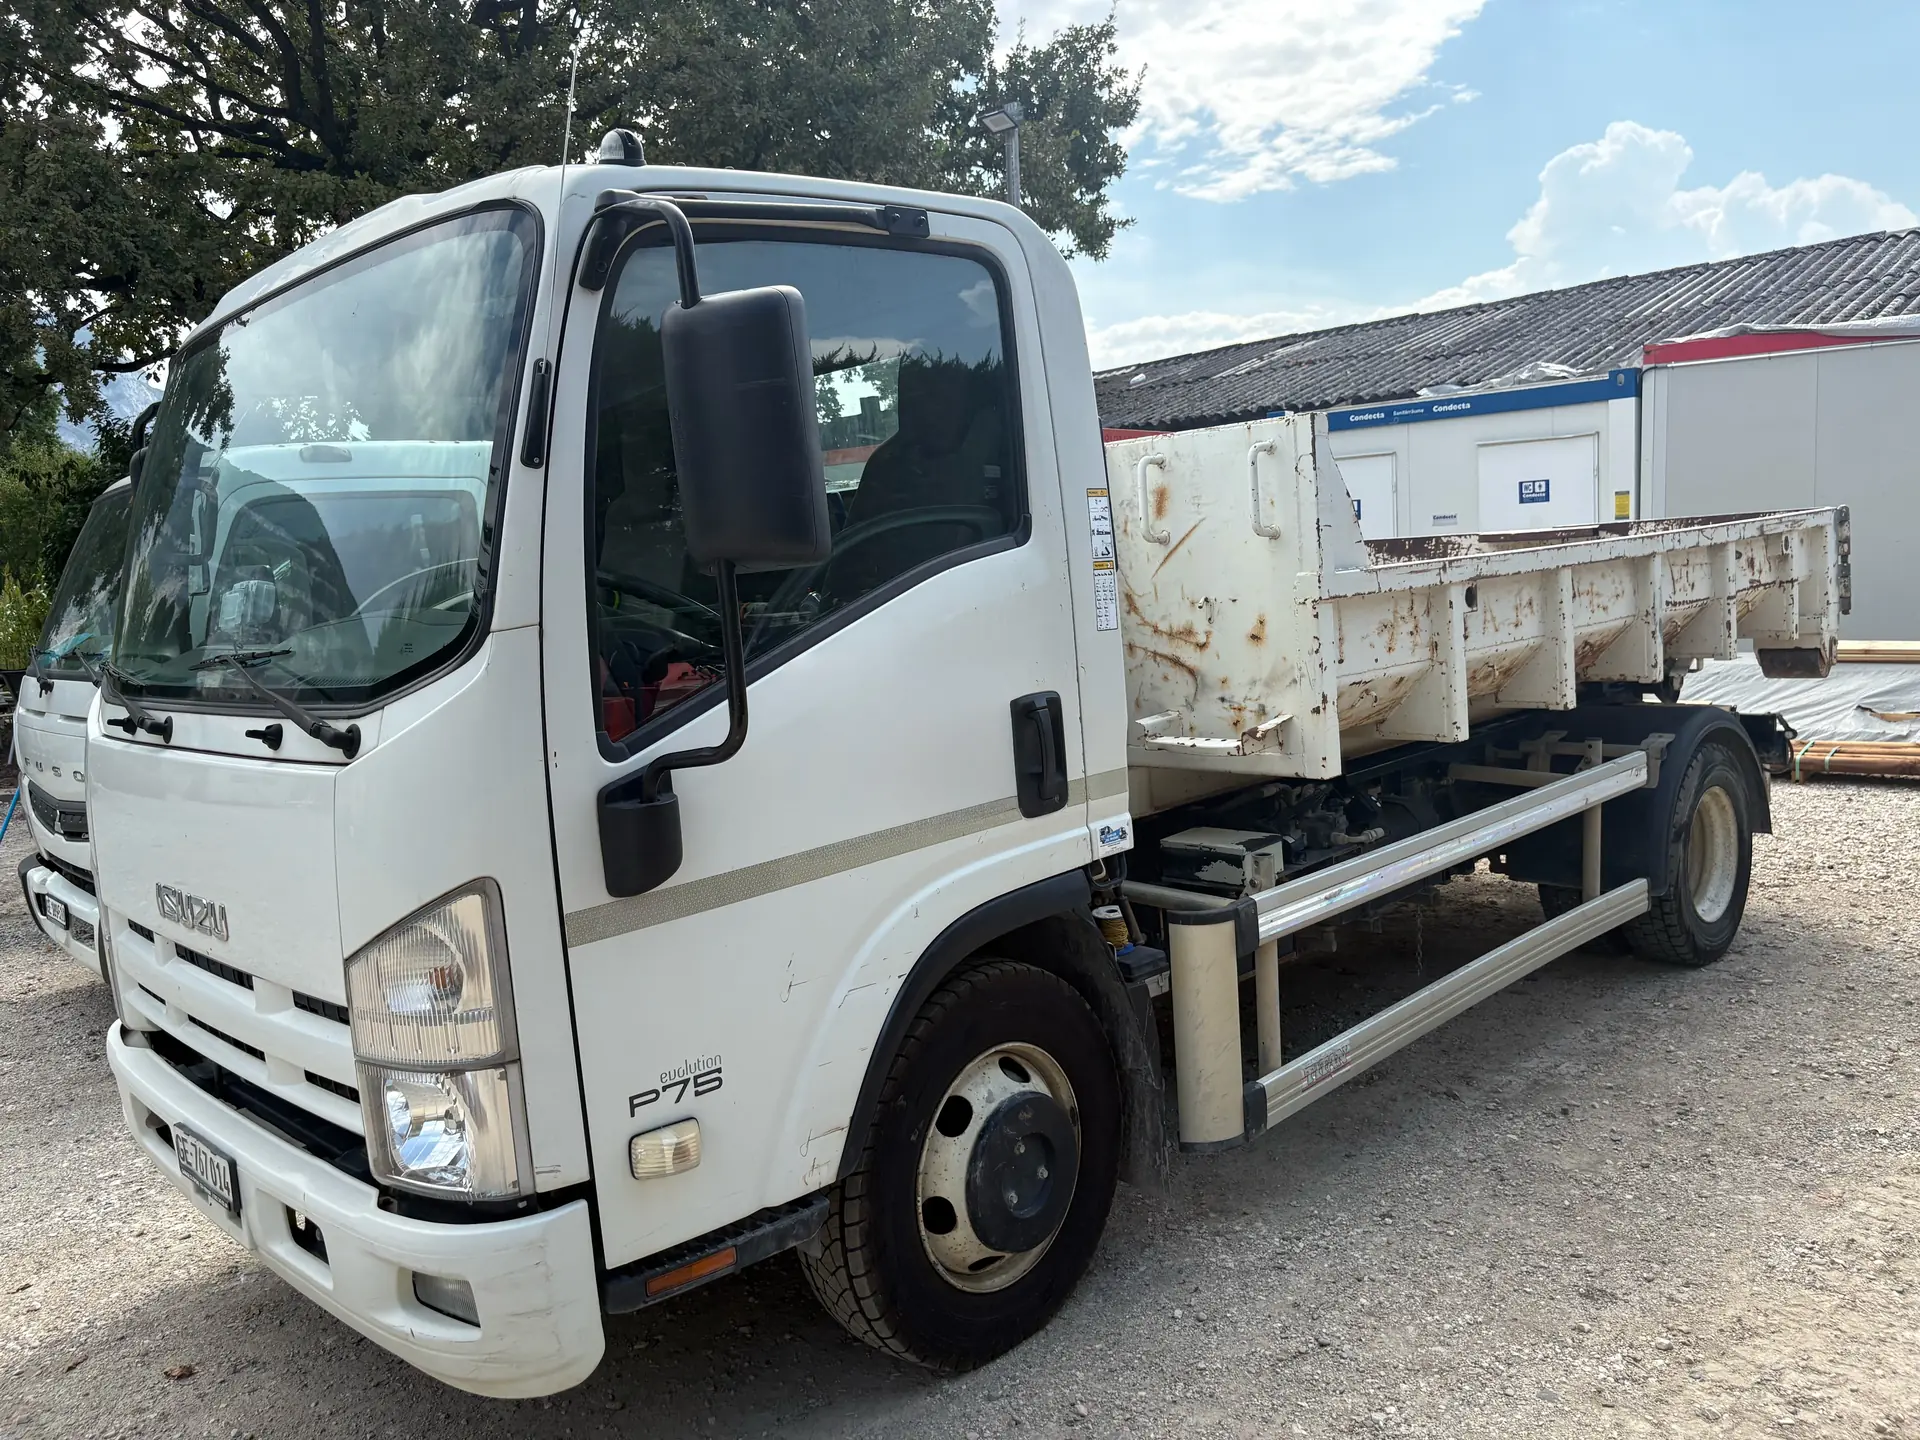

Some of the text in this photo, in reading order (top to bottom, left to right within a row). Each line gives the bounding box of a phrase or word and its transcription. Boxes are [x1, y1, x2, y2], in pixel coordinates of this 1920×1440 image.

[1349, 412, 1385, 422] Condecta
[1432, 402, 1471, 412] Condecta
[1523, 484, 1532, 492] WC
[24, 757, 85, 783] FUSO
[156, 882, 229, 941] ISUZU
[660, 1054, 722, 1084] evolution
[629, 1067, 723, 1118] P75
